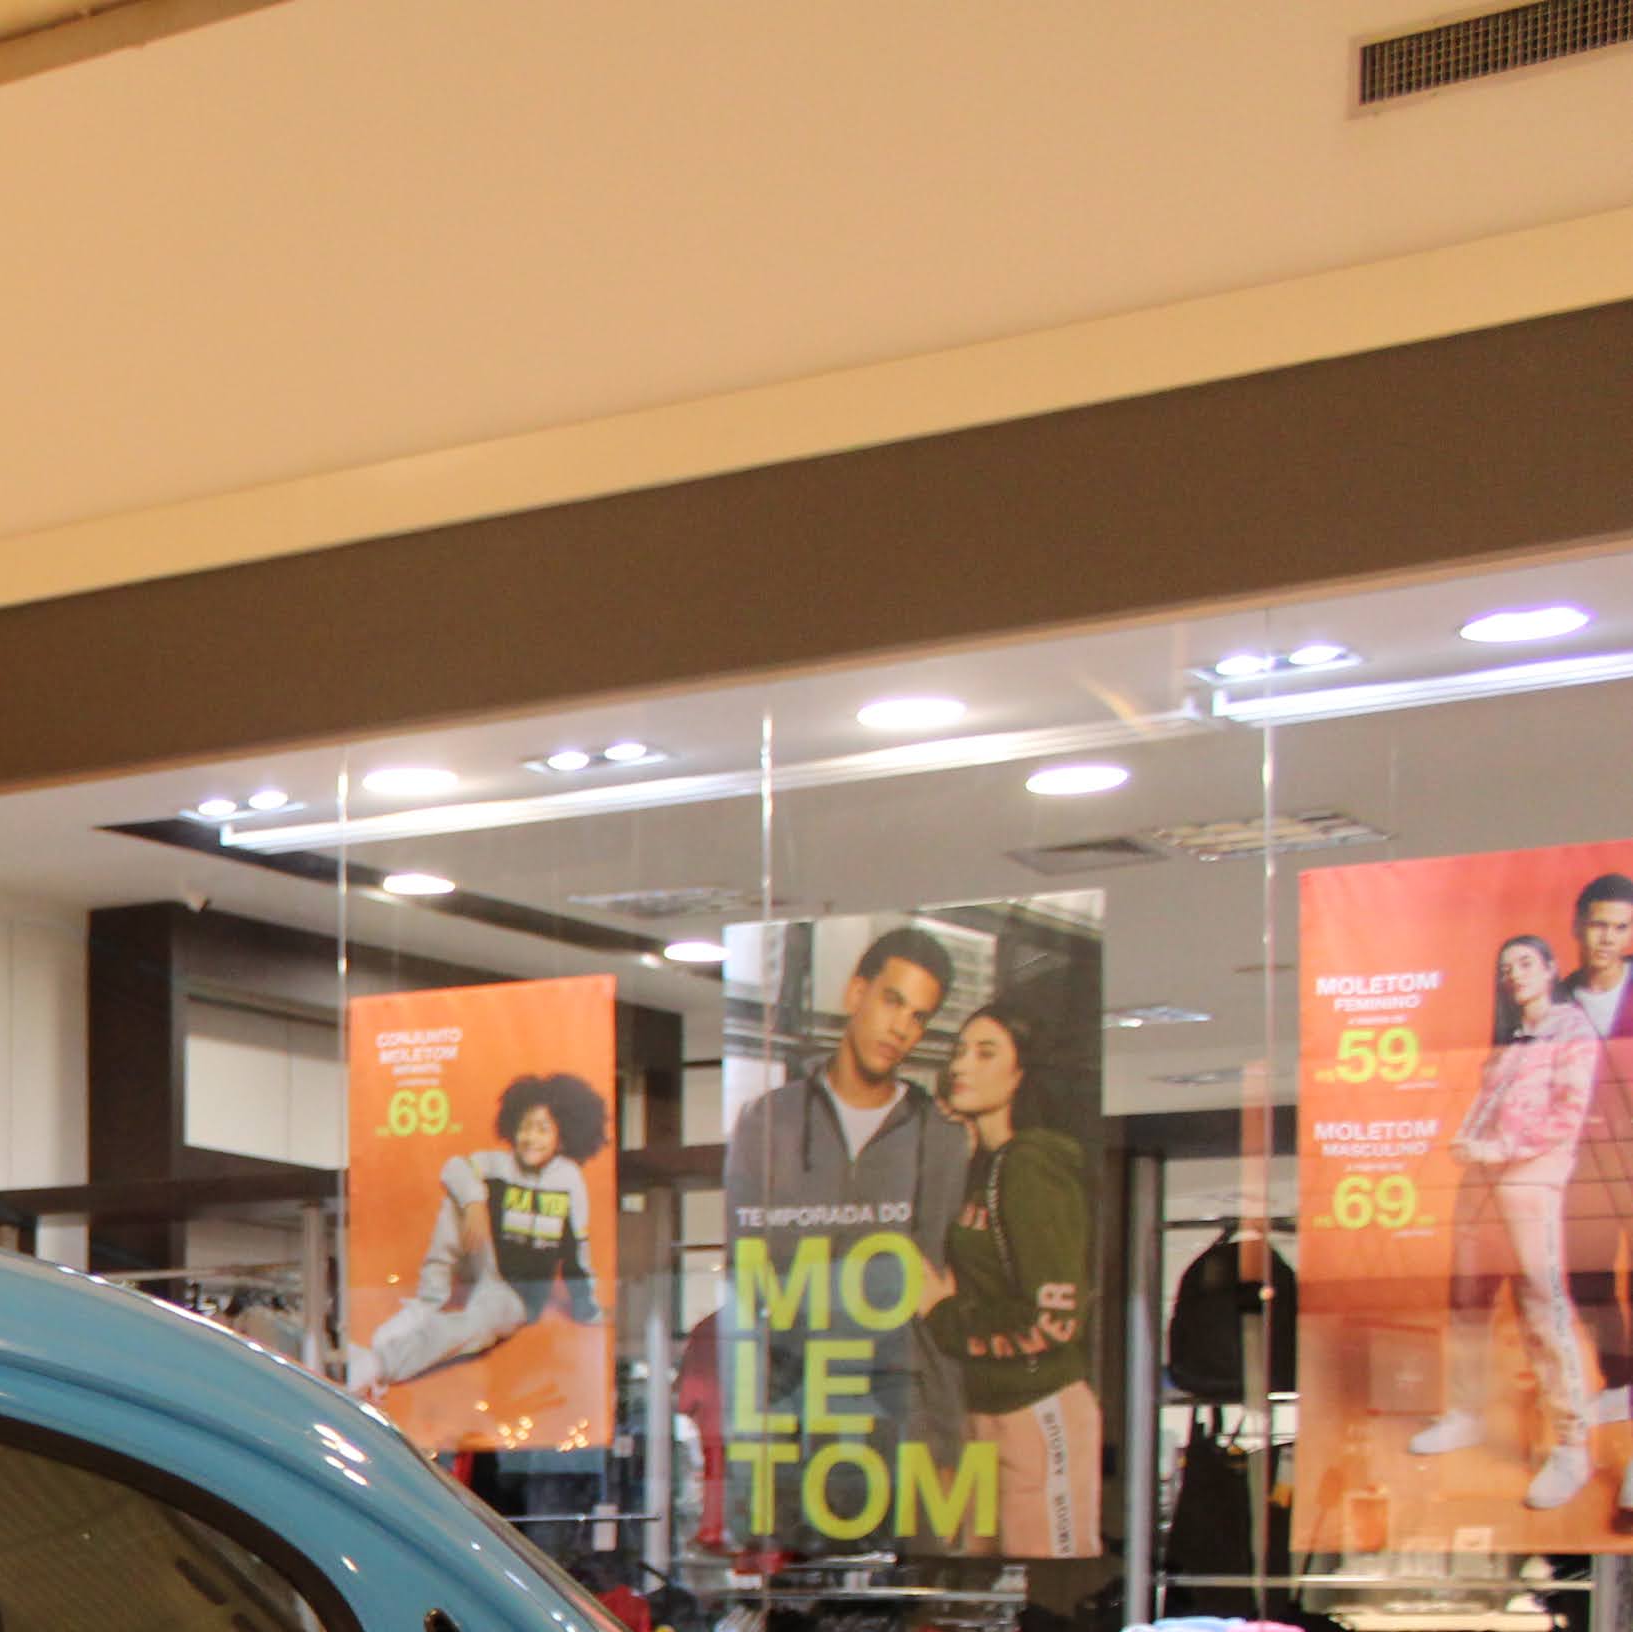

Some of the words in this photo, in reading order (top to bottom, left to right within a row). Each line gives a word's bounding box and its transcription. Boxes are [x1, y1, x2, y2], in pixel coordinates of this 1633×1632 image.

[1316, 972, 1441, 995] MOLETOM
[1336, 1027, 1420, 1083] 59
[388, 1088, 451, 1136] 69
[1313, 1119, 1439, 1140] MOLETOM
[737, 1203, 874, 1227] TEMPORADA
[878, 1202, 913, 1223] DO
[1332, 1174, 1417, 1230] 69
[735, 1231, 924, 1331] MO
[735, 1339, 874, 1434] LE
[727, 1441, 1000, 1540] TOM
